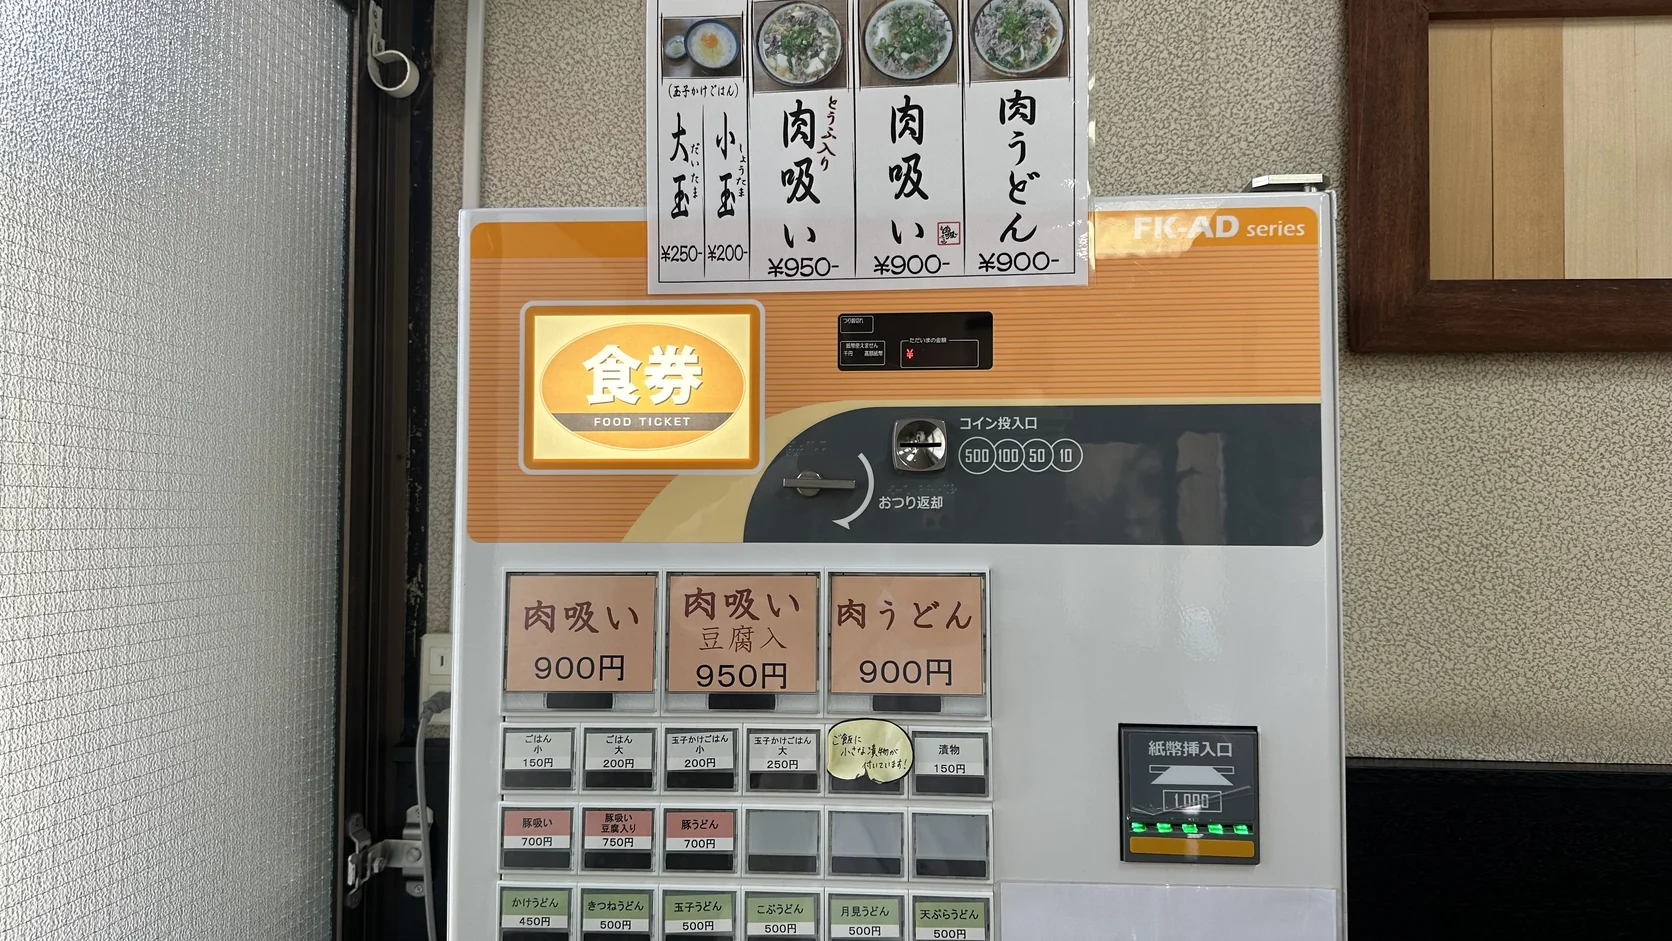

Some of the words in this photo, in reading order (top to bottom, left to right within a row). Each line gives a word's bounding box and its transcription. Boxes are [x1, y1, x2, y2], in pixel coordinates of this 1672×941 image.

[817, 95, 838, 172] とうふ入り
[669, 112, 690, 219] 大玉
[715, 111, 736, 218] 小玉
[888, 94, 930, 245] 肉吸い
[999, 89, 1041, 243] 肉うどん
[780, 98, 821, 249] 肉吸い
[1133, 215, 1240, 240] FK-AD
[1246, 221, 1306, 238] series
[582, 344, 704, 406] 食券
[594, 417, 632, 427] FOOD
[638, 416, 691, 427] TICKET
[959, 416, 1038, 430] コイン投入口
[965, 448, 990, 463] 500
[997, 448, 1019, 463] 100
[1029, 448, 1046, 463] 50
[1059, 448, 1073, 463] 10
[878, 495, 943, 510] おつり返却
[683, 586, 800, 622] 肉吸い
[523, 599, 639, 634] 肉吸い
[836, 598, 973, 630] 肉うどん
[699, 626, 787, 653] 豆腐入
[533, 655, 625, 681] 900円
[859, 659, 953, 686] 900円
[696, 662, 788, 689] 950円
[524, 735, 552, 744] ごはん
[605, 735, 633, 744] ごはん
[671, 735, 729, 744] 玉子かけごはん
[754, 737, 812, 745] 玉子かけごはん
[832, 733, 862, 746] ご飯に
[533, 745, 543, 754] 小
[614, 746, 624, 755] 大
[695, 745, 705, 754] 小
[778, 746, 788, 756] 大
[938, 744, 961, 755] 漬物
[1148, 740, 1233, 757] 紙幣挿入口
[522, 757, 554, 768] 150円
[603, 758, 635, 769] 200円
[684, 758, 717, 768] 200円
[766, 759, 799, 770] 250円
[933, 763, 966, 774] 150円
[521, 816, 553, 829] 豚吸い
[604, 812, 633, 823] 豚吸い
[681, 817, 719, 830] 豚うどん
[601, 823, 637, 834] 豆腐入り
[521, 836, 553, 848] 700円
[602, 836, 634, 848] 750円
[684, 838, 716, 849] 700円
[511, 897, 559, 908] かけうどん
[587, 901, 644, 912] きつねうどん
[674, 901, 722, 913] 玉子うどん
[840, 905, 890, 918] 月見うどん
[920, 908, 979, 920] 天ぷらうどん
[519, 917, 551, 927] 450円
[600, 920, 632, 931] 500円
[682, 921, 714, 932] 500円
[764, 924, 797, 934] 500円
[848, 926, 881, 937] 500円
[933, 929, 966, 940] 500円
